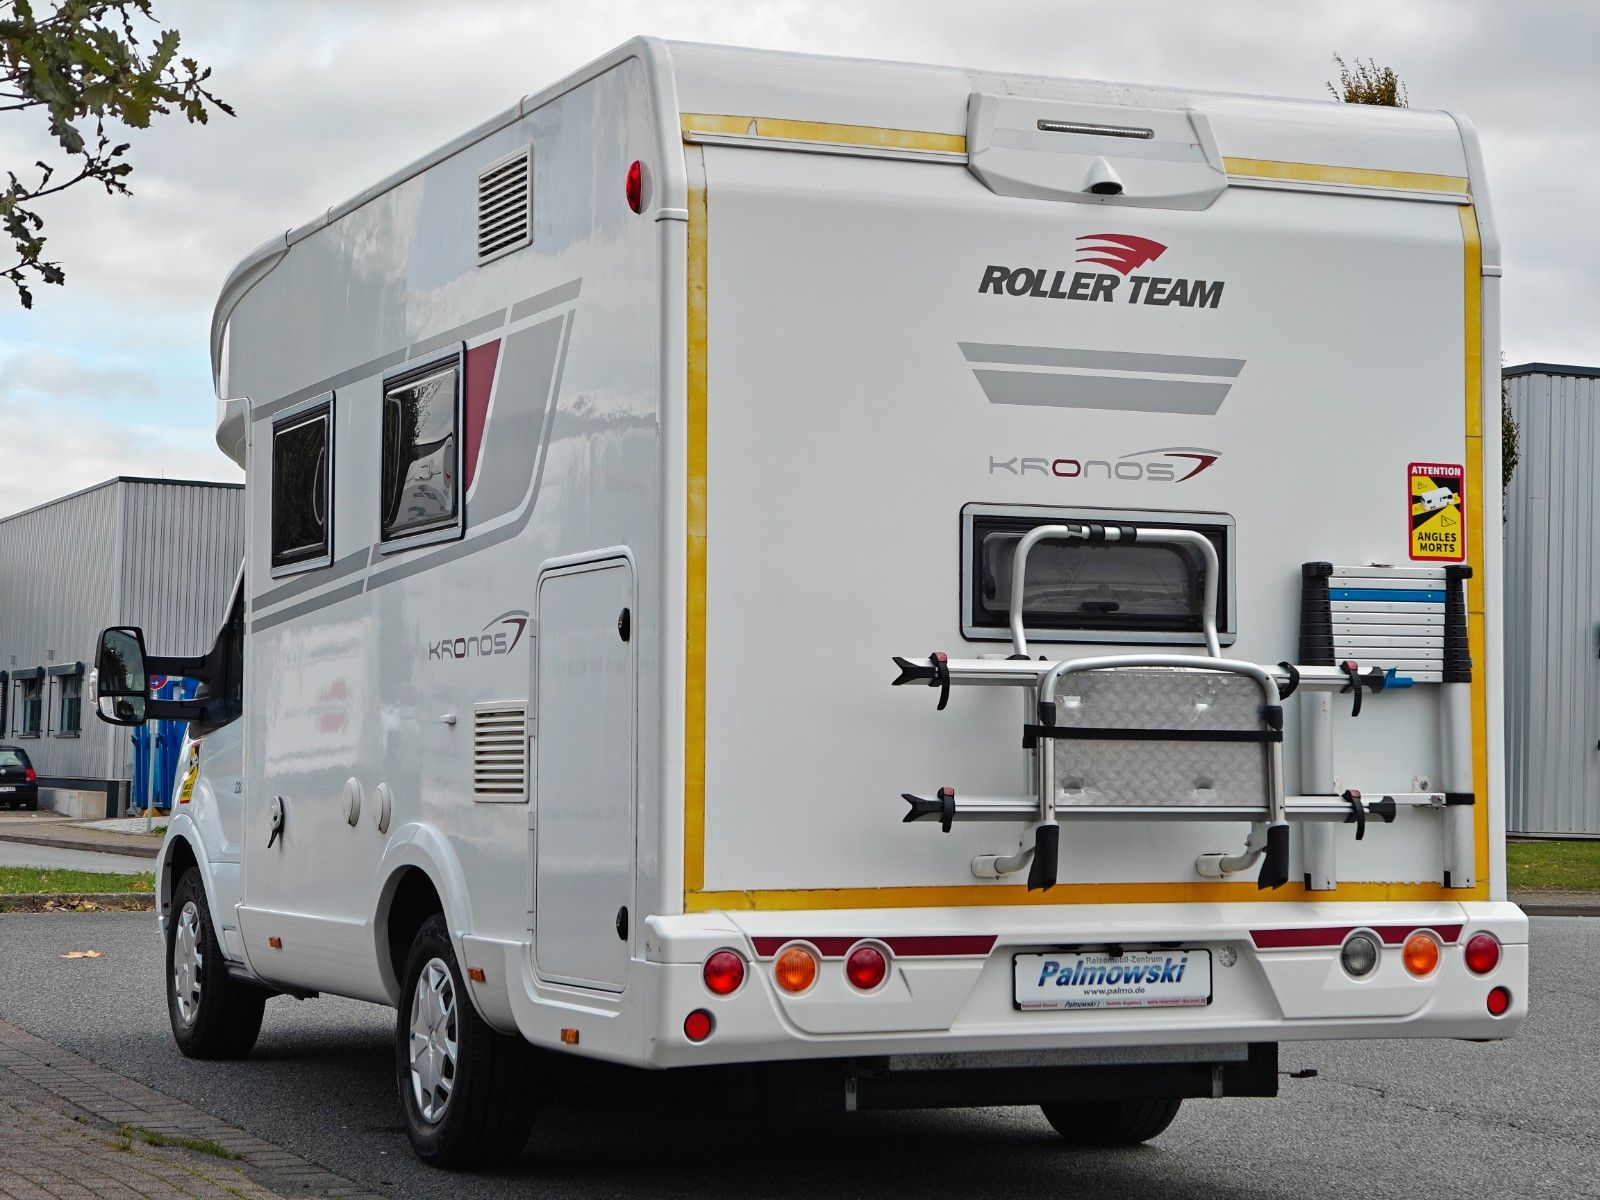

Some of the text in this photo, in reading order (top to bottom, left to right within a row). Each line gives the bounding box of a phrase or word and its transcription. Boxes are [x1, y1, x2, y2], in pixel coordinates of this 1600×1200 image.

[978, 265, 1225, 309] ROLLER TEAM
[989, 455, 1175, 482] KRONOS
[1411, 466, 1461, 476] ATTENTION
[1417, 531, 1457, 542] ANGLES
[1419, 543, 1455, 553] MORTS
[428, 632, 507, 661] KRONOS
[1038, 957, 1187, 987] Palmowski
[1083, 987, 1145, 996] www.palmo.de
